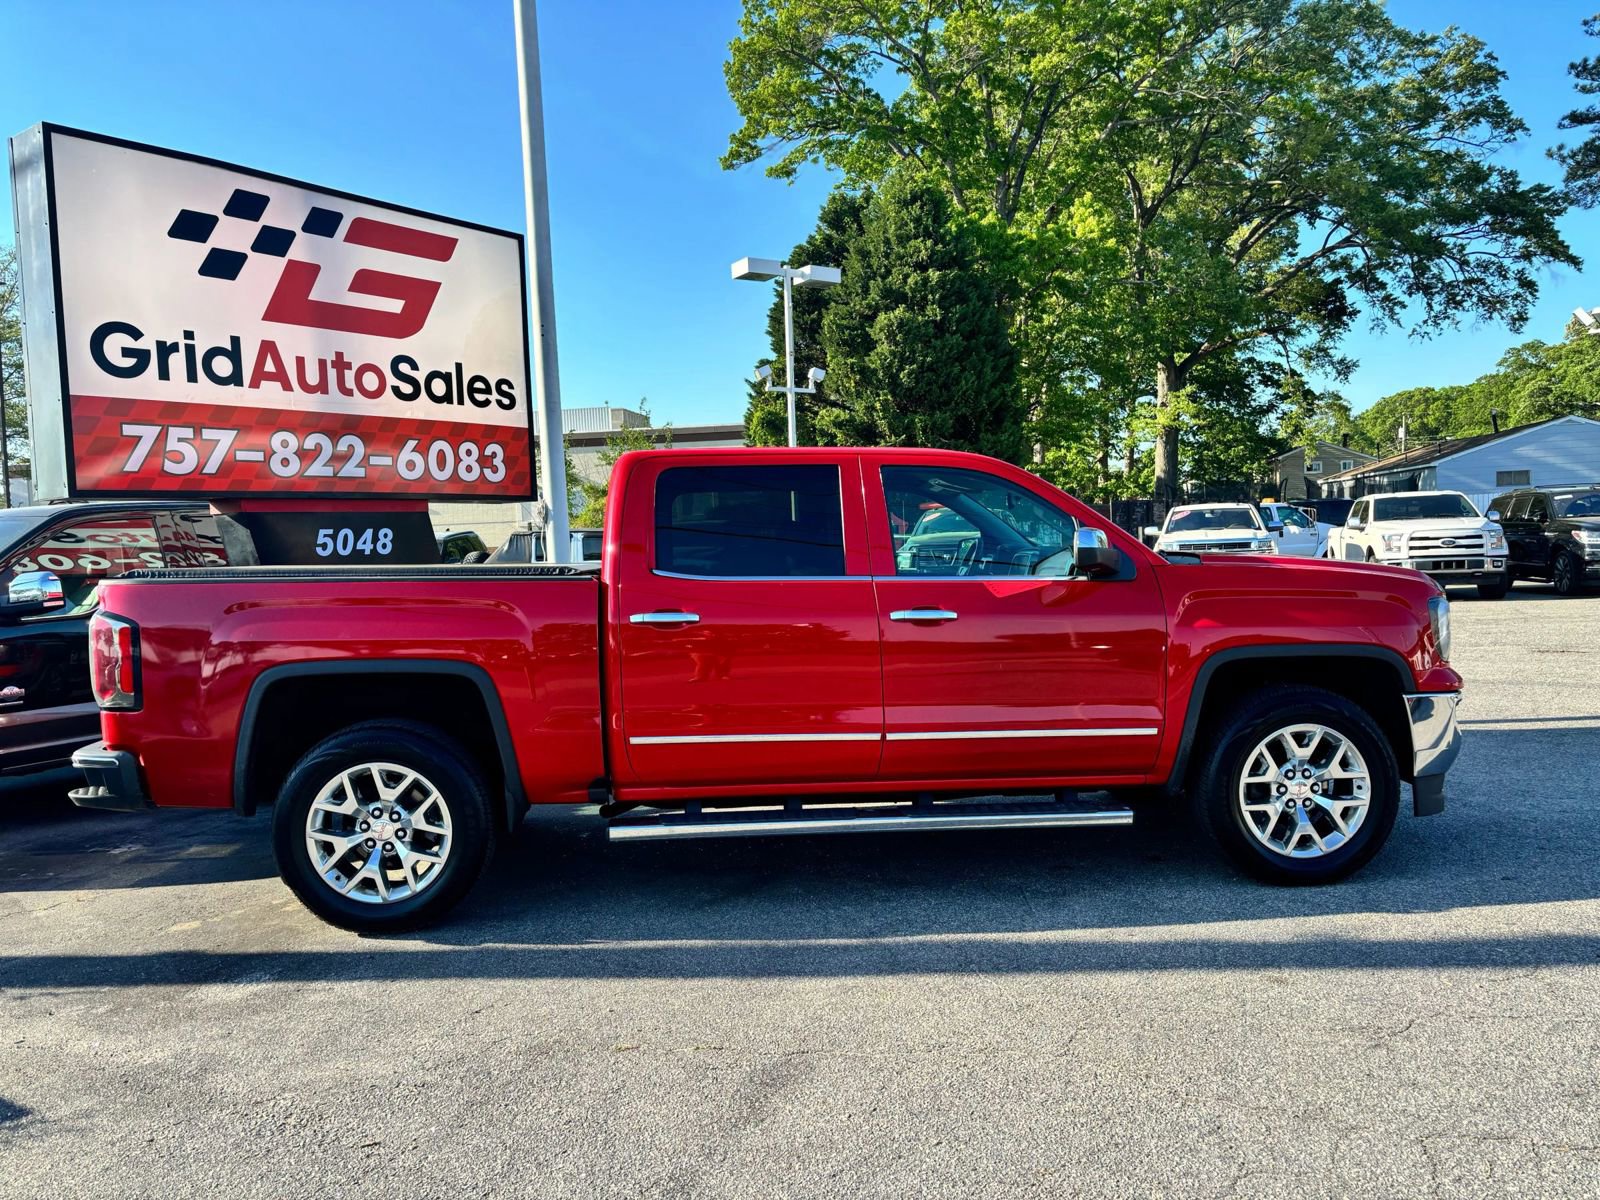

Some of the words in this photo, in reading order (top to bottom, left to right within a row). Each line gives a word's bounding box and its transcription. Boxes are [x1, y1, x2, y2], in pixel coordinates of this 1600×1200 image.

[89, 320, 517, 411] GridAutoSales
[120, 422, 507, 483] 757-822-6083
[315, 527, 394, 557] 5048
